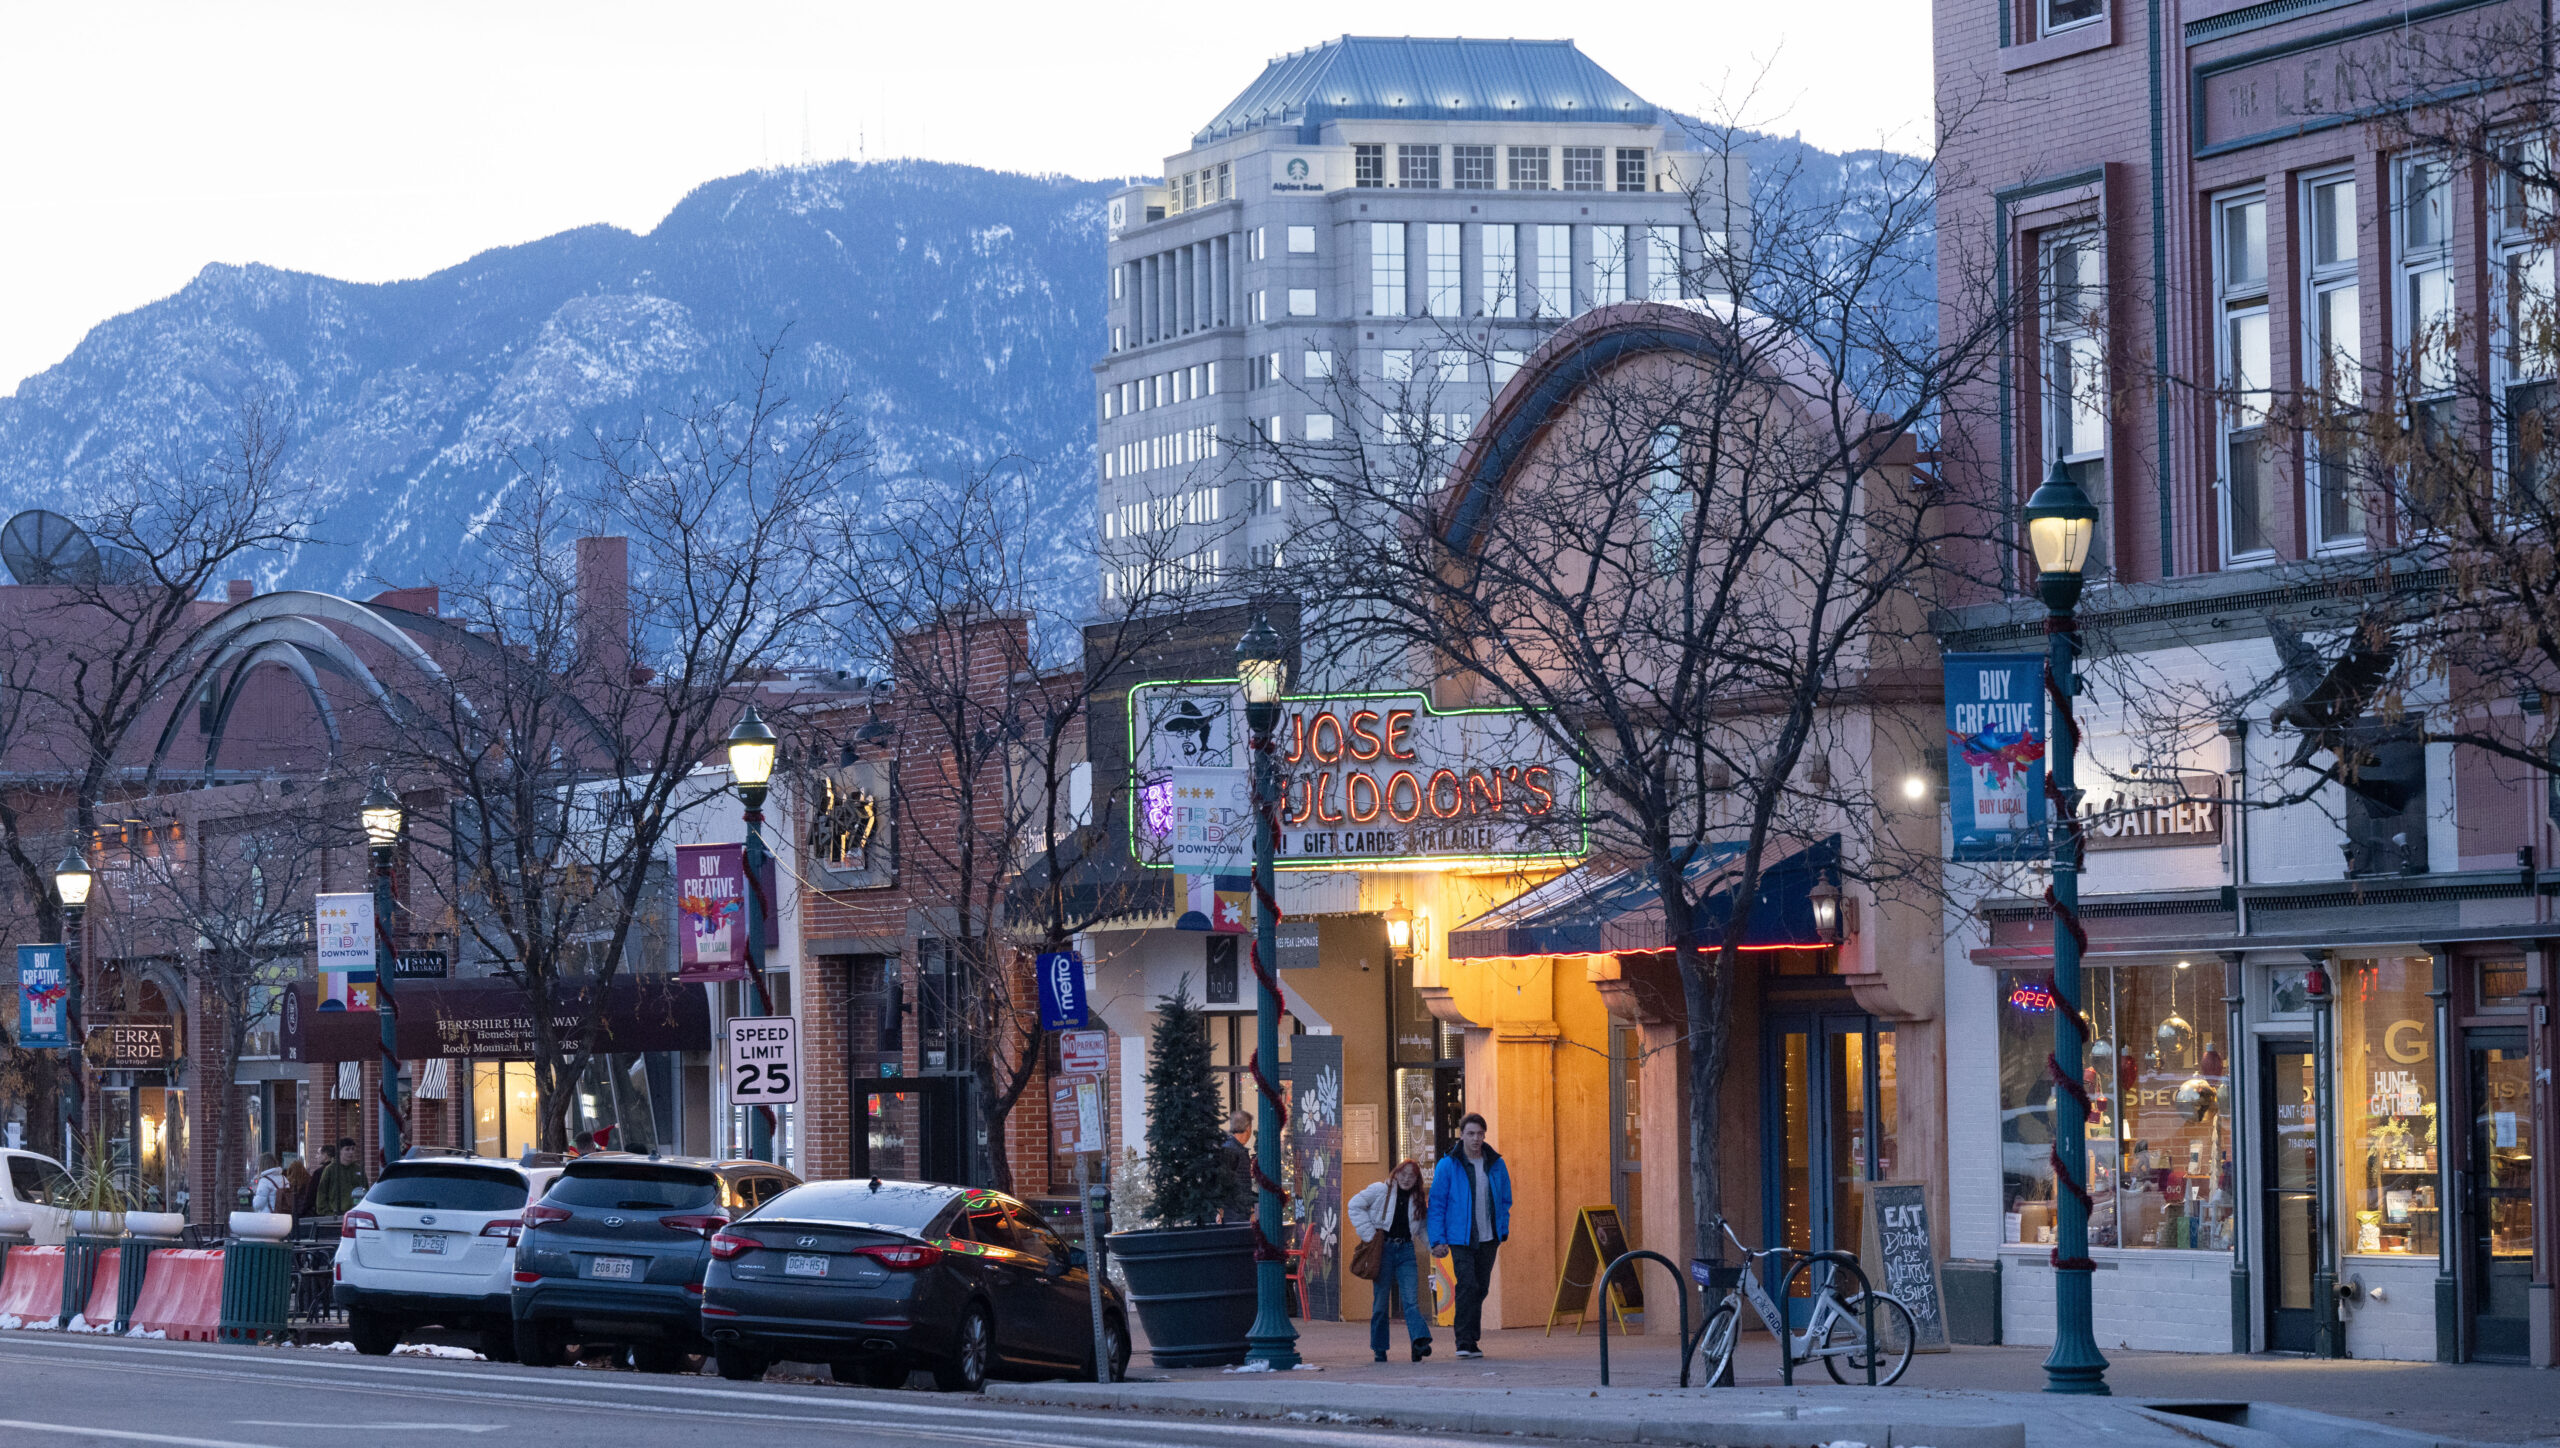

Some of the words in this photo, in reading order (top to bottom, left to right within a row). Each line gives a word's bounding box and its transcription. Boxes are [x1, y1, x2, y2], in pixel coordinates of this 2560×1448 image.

[1979, 670, 2011, 700] BUY
[1285, 710, 1416, 762] JOSE
[1280, 764, 1553, 824] ULDOON'S
[1979, 800, 1995, 814] BUY
[2100, 791, 2214, 838] GATHER
[1177, 807, 1231, 826] FIRST
[1178, 845, 1243, 854] DOWNTOWN
[1304, 832, 1334, 853] GIFT
[699, 855, 720, 876] BUY
[684, 877, 738, 898] CREATIVE.
[321, 923, 358, 934] FIRST
[321, 936, 372, 948] FRIDAY
[700, 942, 710, 952] BUY
[34, 953, 50, 968] BUY
[321, 949, 369, 958] DOWNTOWN
[1057, 958, 1075, 1010] metro
[1211, 974, 1233, 993] halo
[439, 1018, 510, 1030] BERKSHIRE
[114, 1030, 160, 1043] ERRA
[736, 1028, 788, 1041] SPEED
[2384, 1020, 2430, 1064] G
[116, 1045, 161, 1058] ERDE
[443, 1043, 471, 1056] Rocky
[741, 1046, 784, 1059] LIMIT
[1063, 1040, 1076, 1053] NO
[1076, 1041, 1104, 1050] PARKING
[736, 1064, 790, 1095] 25
[2374, 1071, 2409, 1094] HUNT
[2279, 1104, 2295, 1119] HUNT
[2371, 1093, 2422, 1116] GATHER
[1884, 1204, 1922, 1228] EAT
[1883, 1226, 1928, 1255] Drink
[1903, 1250, 1920, 1263] BE
[595, 1262, 610, 1273] 208
[615, 1263, 631, 1274] GTS
[1902, 1285, 1933, 1302] SHOP
